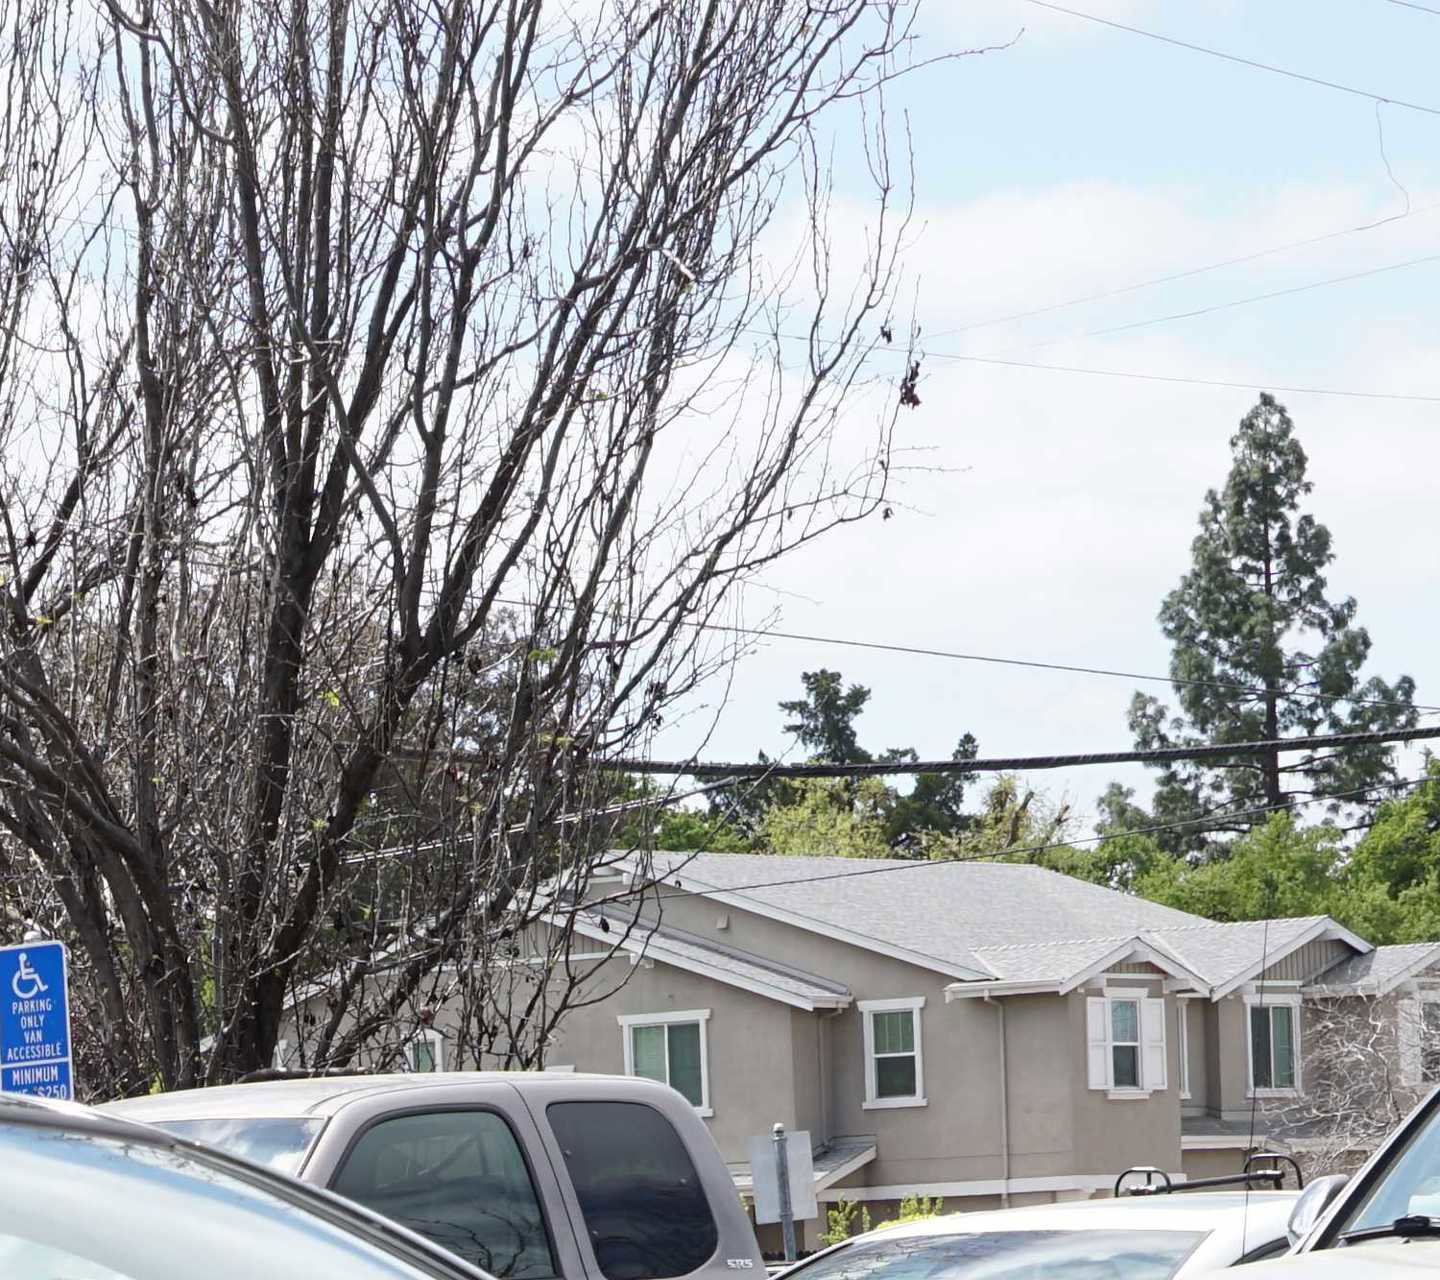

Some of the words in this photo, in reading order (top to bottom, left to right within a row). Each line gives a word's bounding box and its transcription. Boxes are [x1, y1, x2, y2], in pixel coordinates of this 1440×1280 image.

[12, 999, 52, 1014] PARKING
[20, 1015, 45, 1029] ONLY
[24, 1030, 42, 1044] VAN
[7, 1044, 62, 1060] ACCESSIBLE
[12, 1065, 58, 1086] MINIMUM
[727, 1258, 753, 1269] SR5
